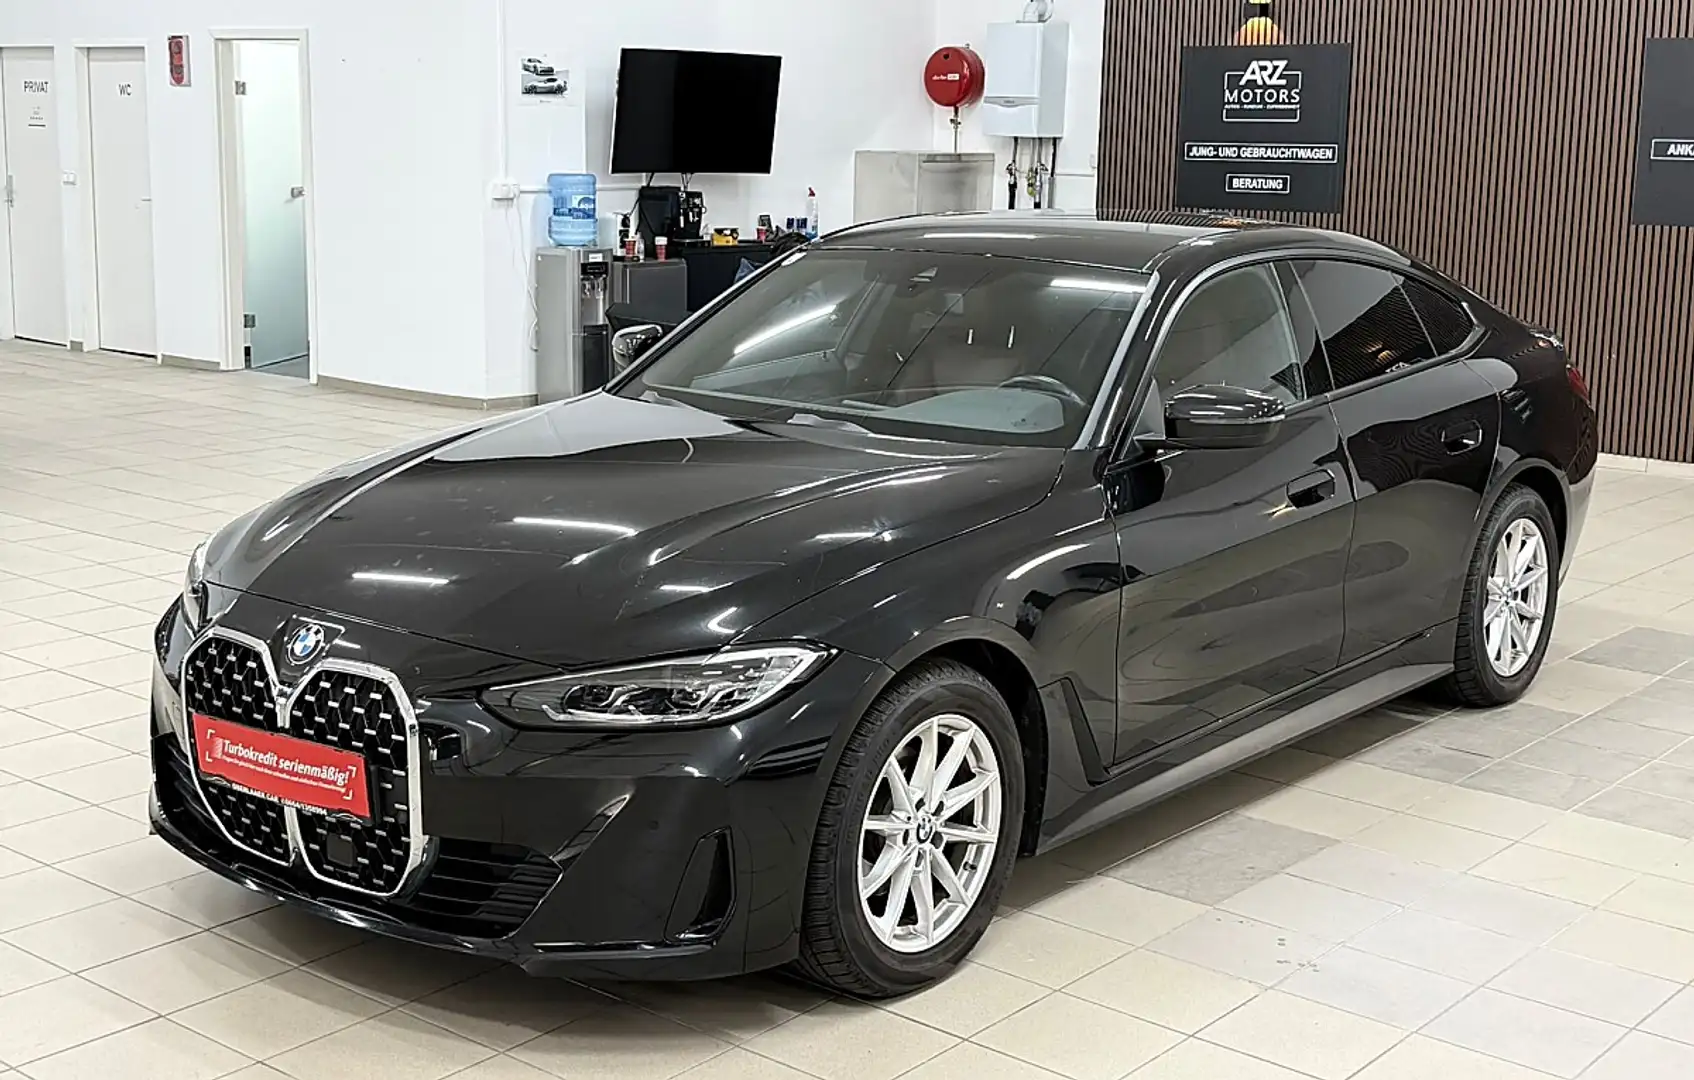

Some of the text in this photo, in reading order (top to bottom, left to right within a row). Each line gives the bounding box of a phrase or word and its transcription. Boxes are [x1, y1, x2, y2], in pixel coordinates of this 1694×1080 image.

[1239, 60, 1288, 86] ARZ
[23, 80, 49, 93] PRIVAT
[118, 83, 132, 96] WC
[1224, 88, 1300, 103] MOTORS
[1189, 146, 1333, 160] JUNG- UND GEBRAUCHTWAGEN
[1667, 143, 1694, 157] ANK
[1232, 177, 1283, 190] BERATUNG
[223, 739, 278, 768] Turbokredit
[278, 757, 349, 786] serienmäßig!
